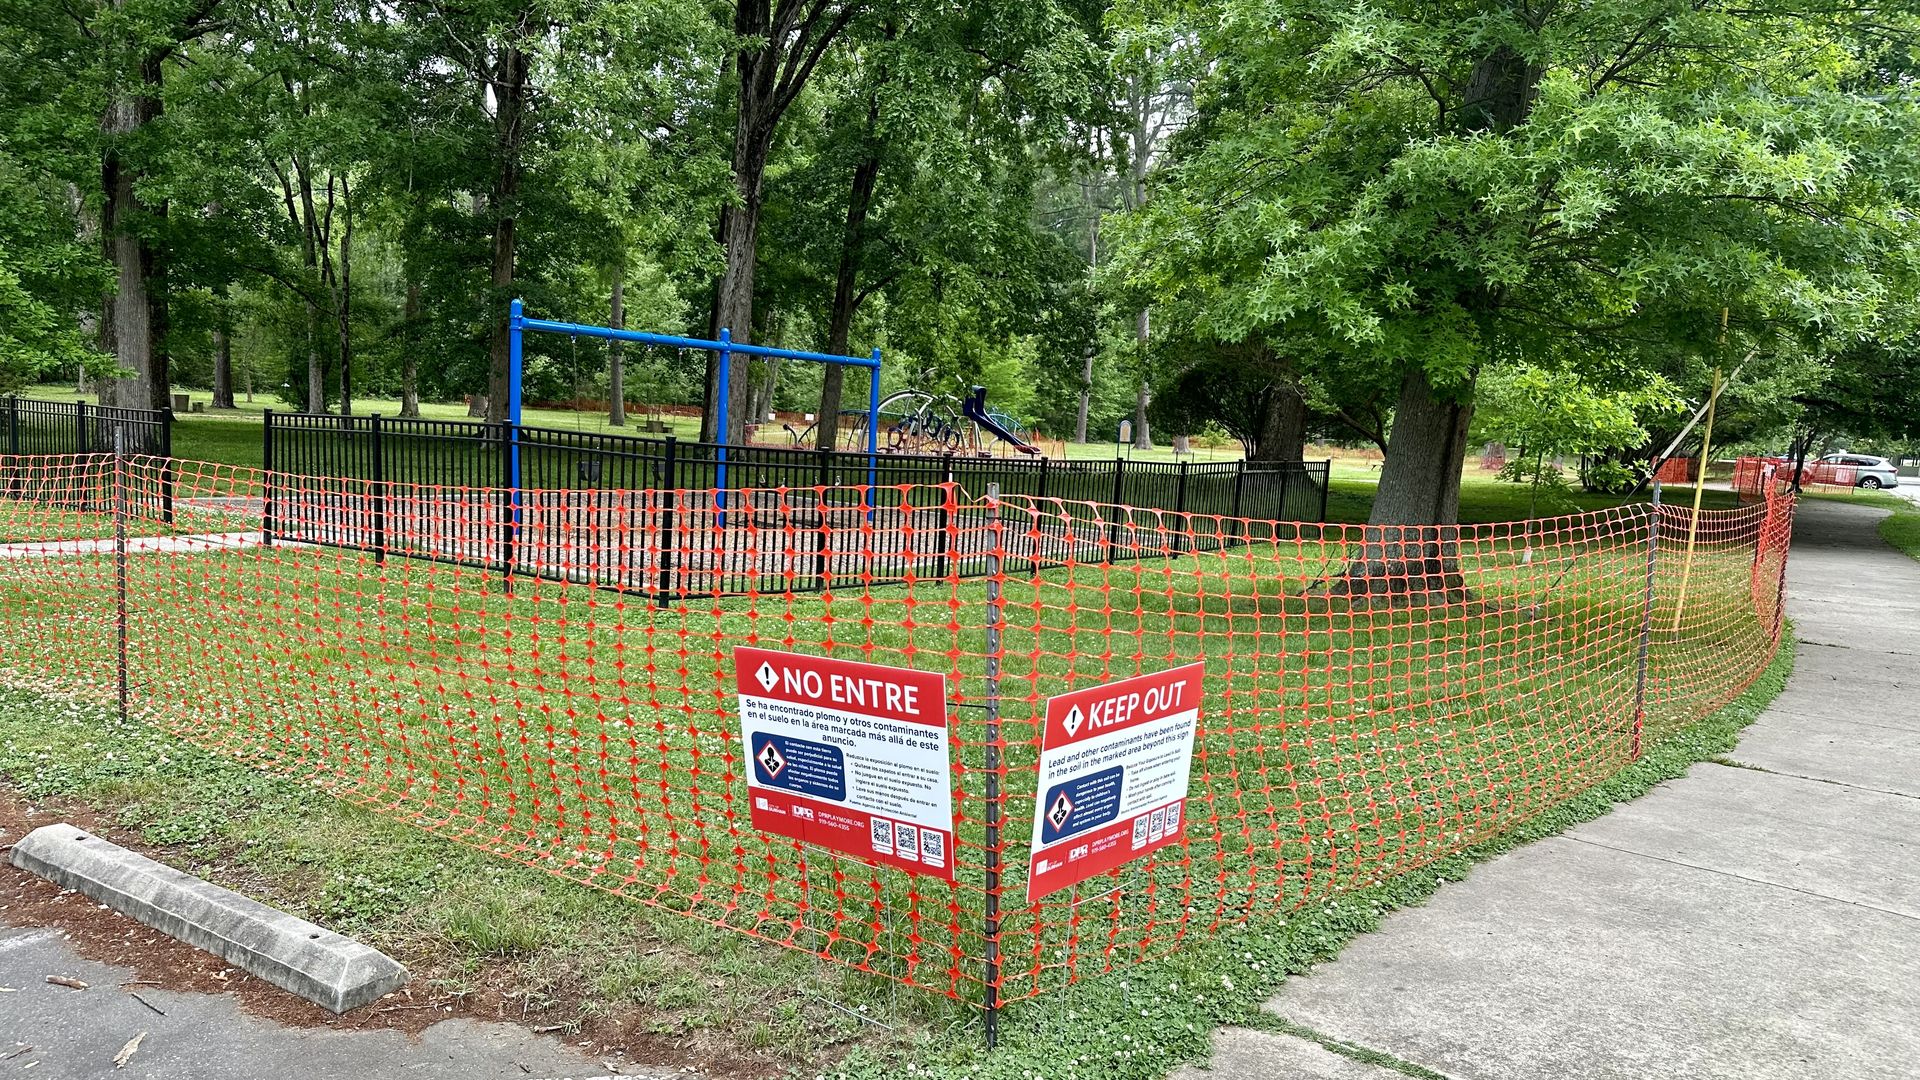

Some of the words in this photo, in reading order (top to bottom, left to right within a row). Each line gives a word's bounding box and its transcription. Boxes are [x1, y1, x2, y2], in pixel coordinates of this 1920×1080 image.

[783, 667, 823, 699] NO
[830, 674, 919, 714] ENTRE
[1088, 693, 1140, 730] KEEP
[1143, 680, 1187, 715] OUT
[746, 698, 756, 708] Se
[757, 700, 767, 709] ha
[769, 703, 813, 717] encontrado
[815, 710, 841, 723] plomo
[842, 717, 847, 725] y
[849, 717, 871, 728] otros
[873, 721, 938, 739] contaminantes
[758, 711, 766, 720] el
[767, 712, 788, 723] suelo
[790, 718, 800, 726] en
[802, 718, 809, 727] la
[811, 722, 828, 731] área
[831, 724, 866, 738] marcada
[868, 730, 886, 741] más
[888, 733, 903, 744] allá
[905, 737, 917, 747] de
[919, 740, 938, 751] este
[822, 732, 856, 747] anuncio.
[1048, 755, 1065, 768] Lead
[1066, 751, 1080, 763] and
[1081, 746, 1099, 758] other
[1100, 734, 1142, 753] contaminants
[1143, 729, 1158, 740] have
[1159, 724, 1173, 735] been
[1174, 719, 1191, 730] found
[1048, 769, 1054, 779] in
[1056, 765, 1067, 777] the
[1069, 761, 1081, 773] soil
[1090, 755, 1101, 766] the
[1102, 748, 1126, 762] marked
[1127, 745, 1141, 755] area
[1142, 737, 1164, 752] beyond
[1165, 733, 1176, 743] this
[1176, 730, 1188, 741] sign
[791, 804, 813, 819] DPR
[1069, 843, 1088, 860] DPR
